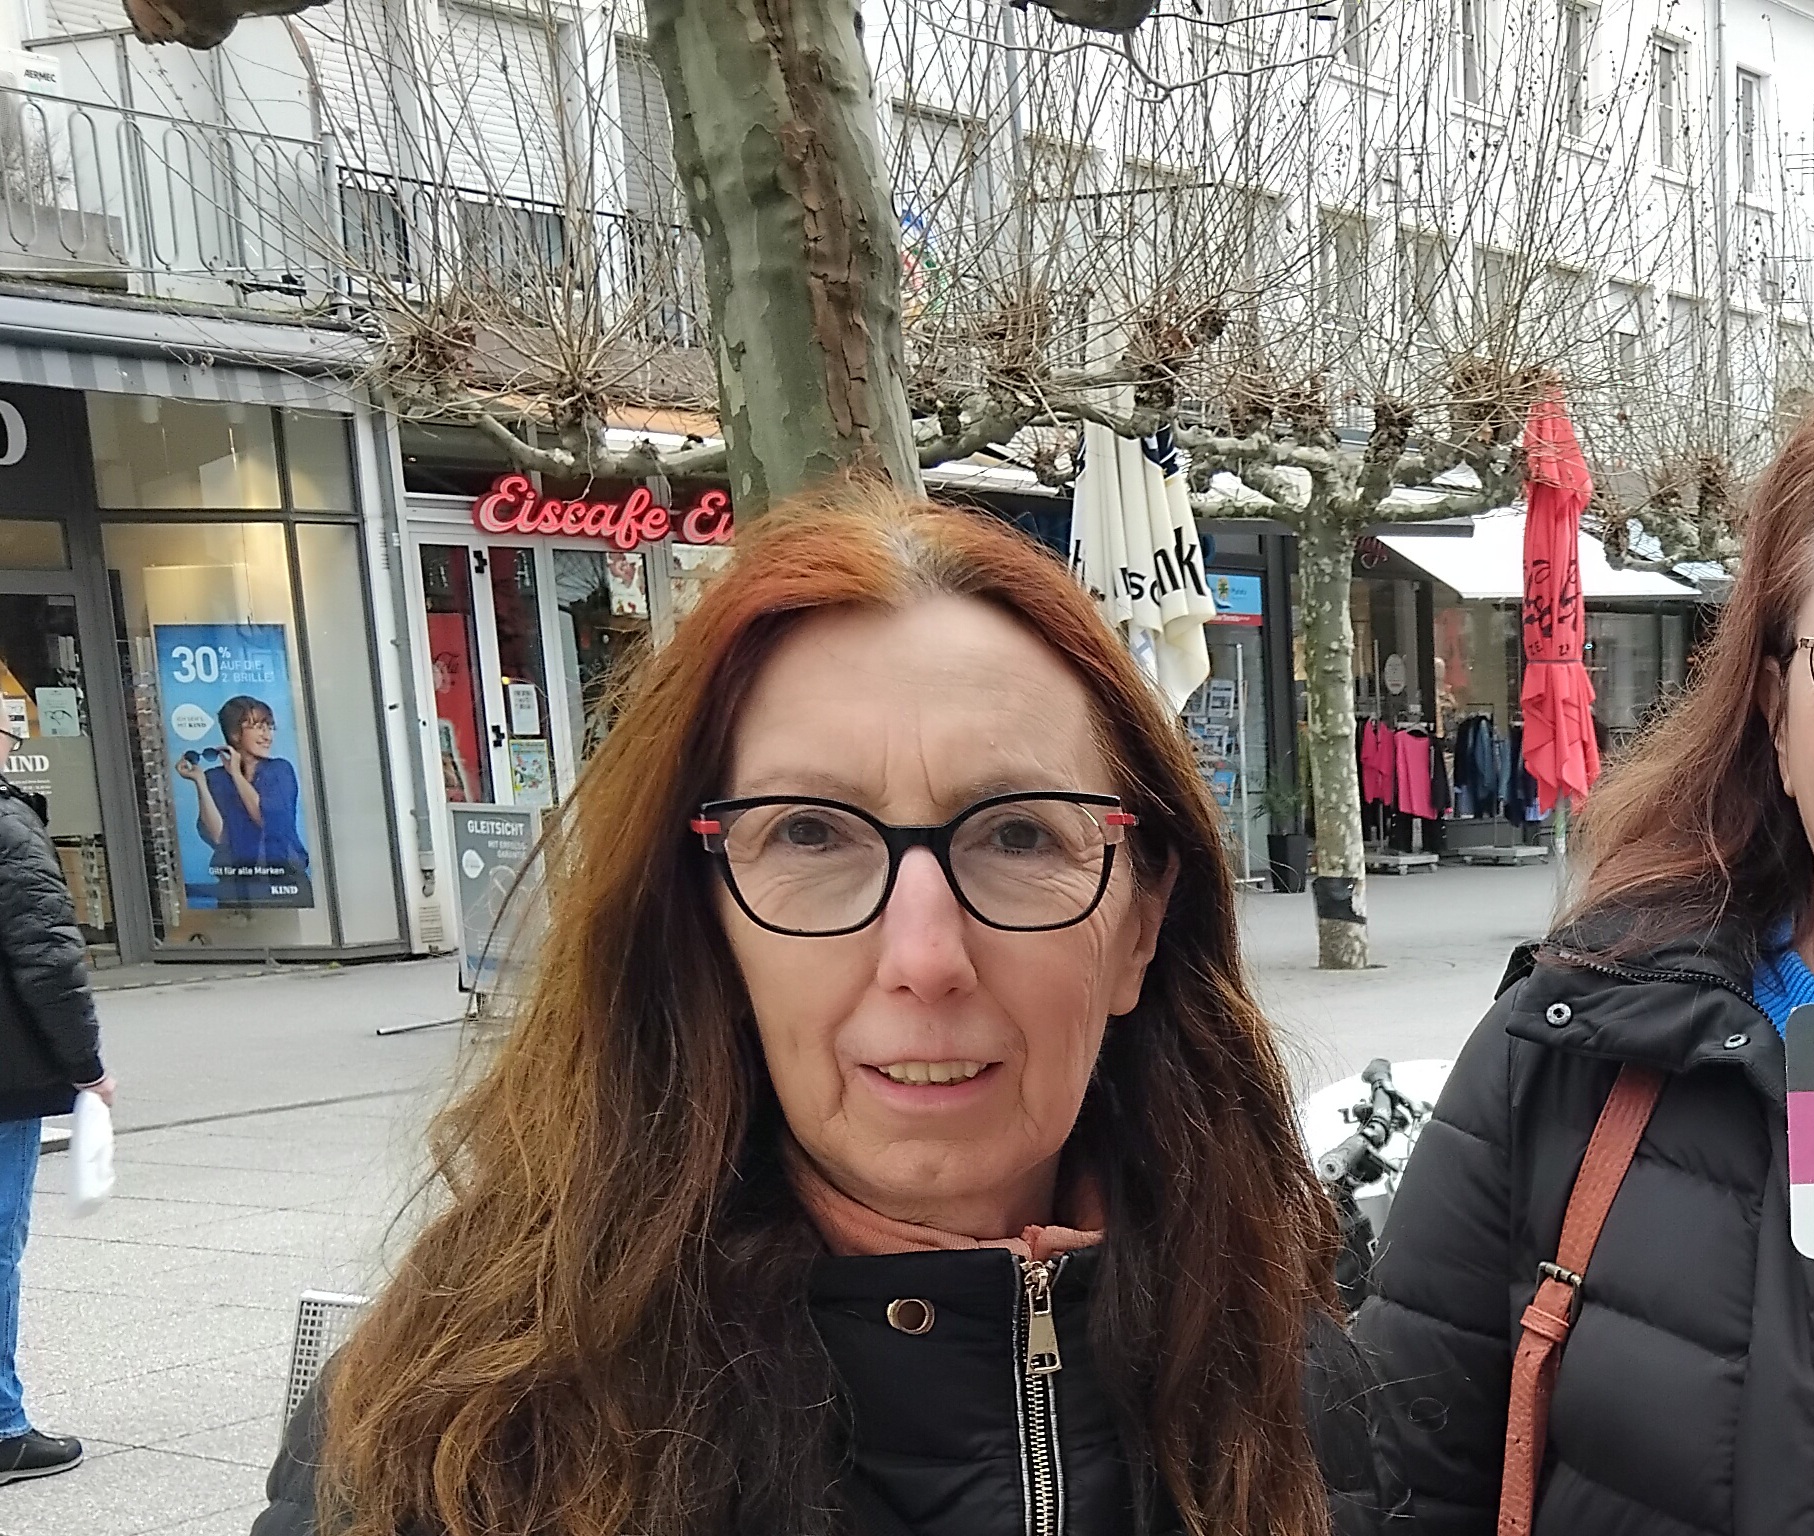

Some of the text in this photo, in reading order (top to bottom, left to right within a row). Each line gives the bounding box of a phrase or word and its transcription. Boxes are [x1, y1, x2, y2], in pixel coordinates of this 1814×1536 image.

[220, 660, 241, 670] AUF
[467, 819, 525, 836] GLEITSICHT
[254, 866, 285, 875] Marken
[271, 885, 298, 895] KIND
